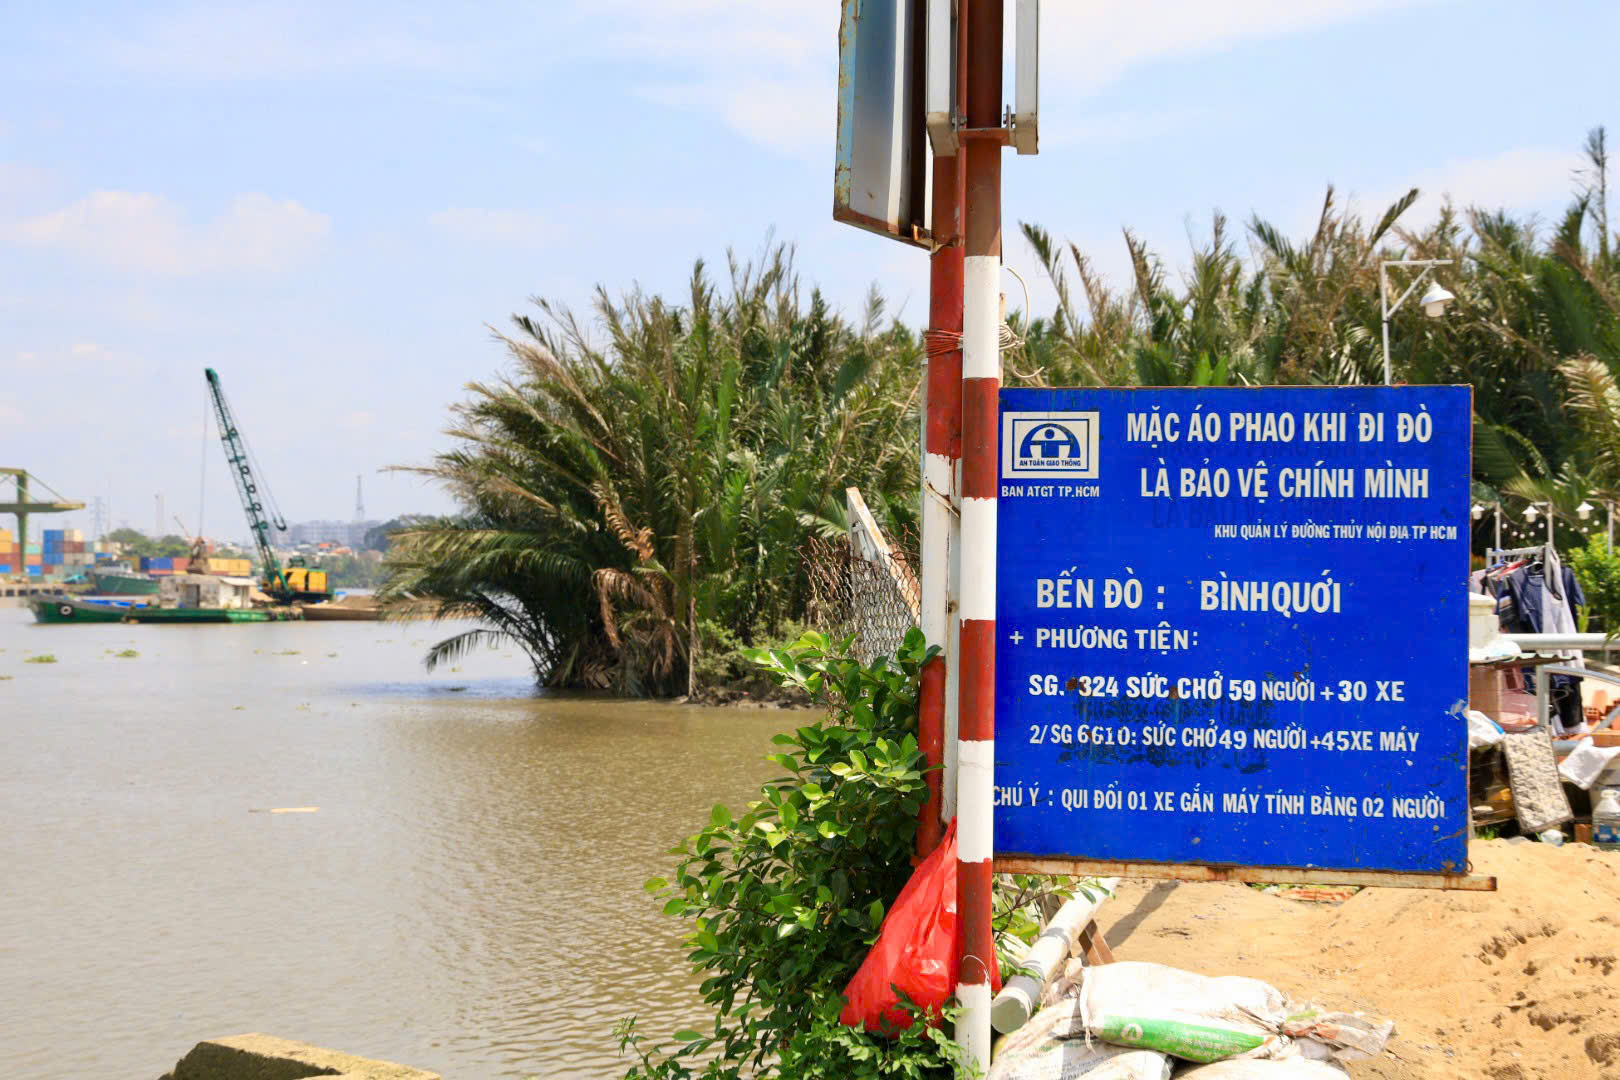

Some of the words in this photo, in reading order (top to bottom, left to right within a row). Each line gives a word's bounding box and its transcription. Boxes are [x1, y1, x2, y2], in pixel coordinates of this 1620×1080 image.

[1127, 405, 1180, 448] MẶC
[1187, 404, 1221, 442] ÁO
[1230, 412, 1295, 442] PHAO
[1303, 412, 1346, 442] KHI
[1358, 412, 1384, 442] ĐI
[1397, 403, 1433, 443] ĐÒ
[1001, 485, 1024, 497] BAN
[1027, 485, 1055, 497] ATGT
[1058, 485, 1100, 498] TP.HCM
[1141, 457, 1171, 497] LÀ
[1180, 458, 1230, 497] BẢO
[1237, 460, 1269, 503] VỆ
[1278, 460, 1354, 498] CHÍNH
[1364, 459, 1429, 498] MÌNH
[1214, 524, 1238, 538] KHU
[1240, 518, 1271, 540] QUẢN
[1274, 521, 1289, 538] LÝ
[1292, 519, 1331, 539] ĐƯỜNG
[1332, 519, 1364, 539] THỦY
[1366, 521, 1387, 542] NỘI
[1389, 525, 1410, 543] ĐỊA
[1411, 525, 1428, 540] TP
[1430, 525, 1457, 540] HCM
[1036, 566, 1094, 609] BẾN
[1103, 566, 1143, 609] ĐÒ
[1009, 630, 1024, 645] +
[1036, 624, 1128, 649] PHƯƠNG
[1134, 620, 1198, 655] TIỆN:
[1029, 674, 1065, 696] SG.
[1078, 675, 1119, 697] 324
[1126, 671, 1169, 698] SỨC
[1177, 670, 1223, 699] CHỞ
[1228, 679, 1256, 701] 59
[1261, 674, 1315, 701] NGƯỜI
[1375, 680, 1405, 701] XE
[1142, 720, 1177, 747] SỨC
[1253, 721, 1307, 749] NGƯỜI
[1379, 725, 1420, 751] MÁY
[992, 780, 1023, 806] CHÚ
[1028, 781, 1040, 807] Ý
[1061, 788, 1088, 812] QUI
[1093, 780, 1123, 809] ĐỔI
[1127, 790, 1148, 811] 01
[1153, 791, 1175, 812] XE
[1180, 782, 1214, 813] GẮN
[1222, 787, 1260, 814] MÁY
[1264, 789, 1305, 815] TÍNH
[1310, 785, 1358, 817] BẰNG
[1362, 796, 1385, 818] 02
[1392, 791, 1445, 819] NGƯỜI
